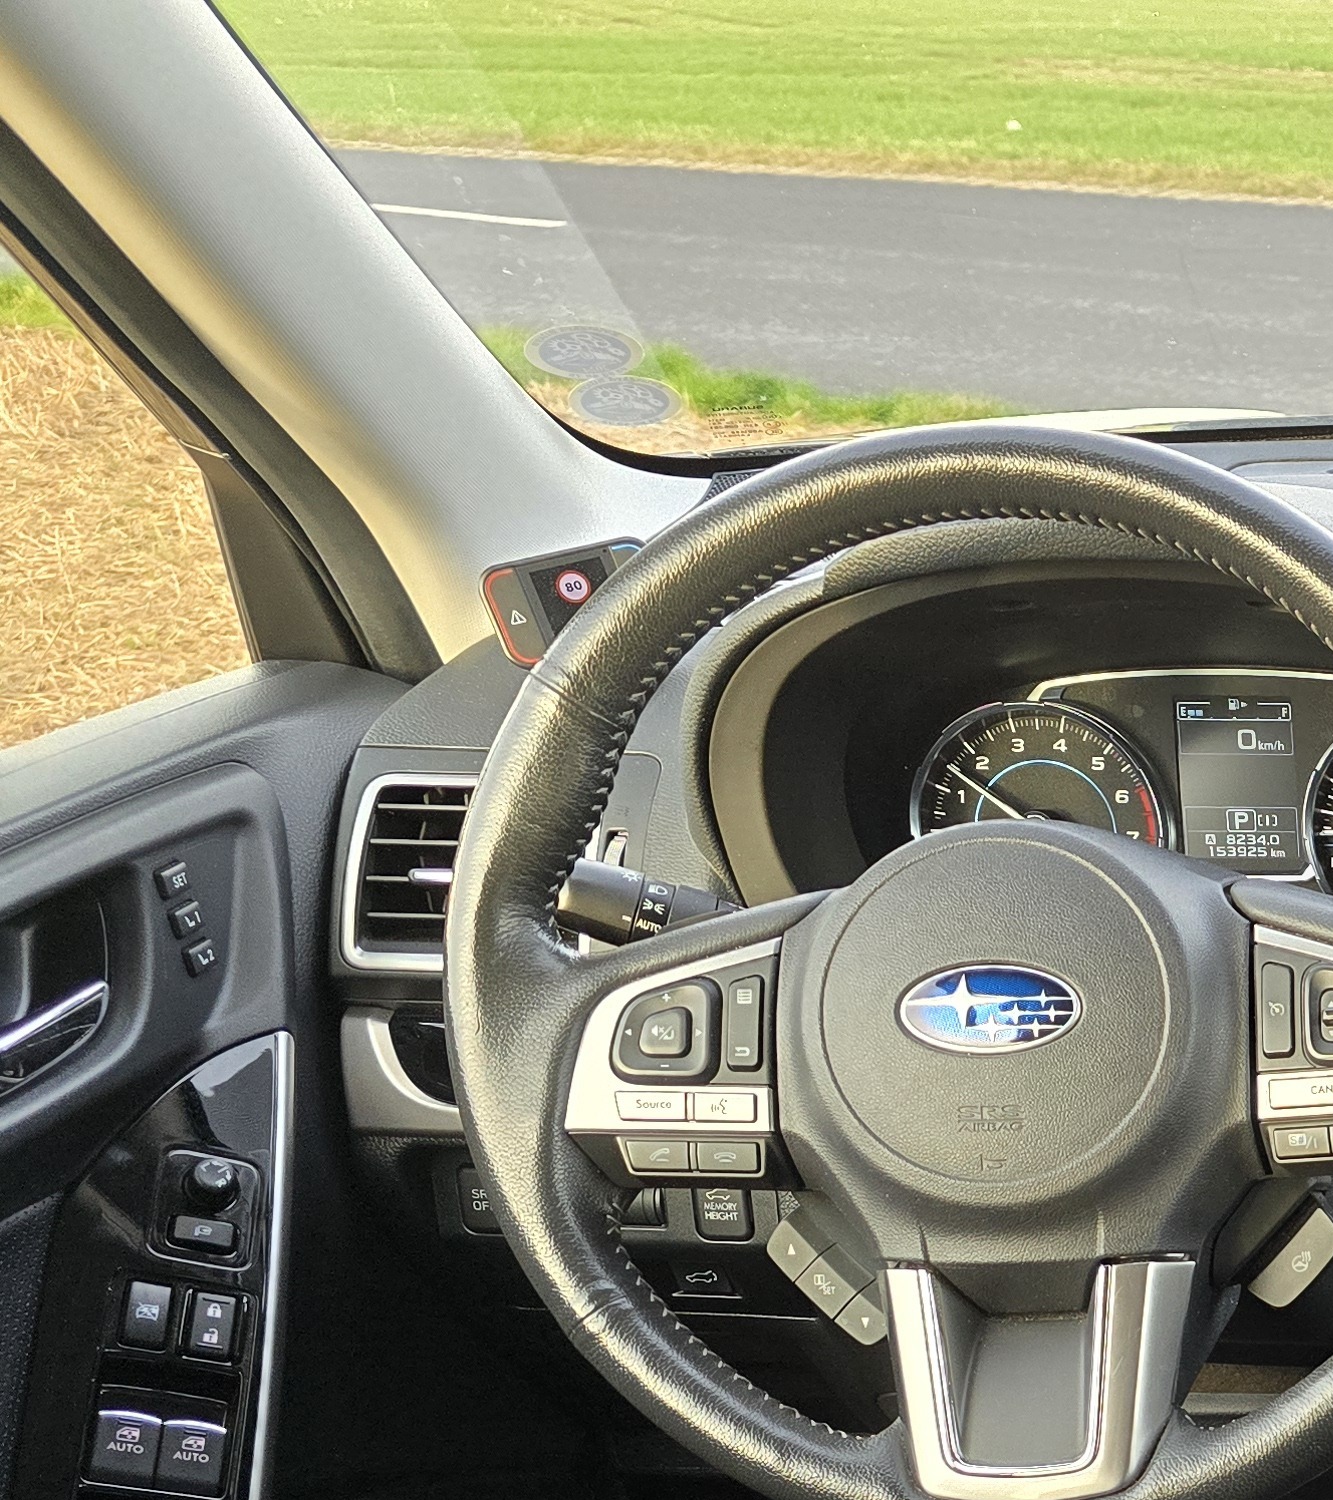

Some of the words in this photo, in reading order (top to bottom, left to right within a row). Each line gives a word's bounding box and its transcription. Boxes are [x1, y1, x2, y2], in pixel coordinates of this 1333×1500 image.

[565, 580, 583, 593] 80
[1180, 707, 1187, 717] E
[1281, 707, 1288, 717] F
[1011, 738, 1025, 752] 3
[1052, 738, 1067, 752] 4
[1237, 729, 1256, 750] 0
[1258, 740, 1285, 751] km/h
[976, 756, 990, 770] 2
[1091, 757, 1105, 771] 5
[957, 790, 965, 804] 1
[1115, 790, 1129, 804] 6
[1234, 811, 1249, 829] P
[1226, 834, 1280, 845] 8234.0
[1209, 846, 1268, 857] 153925
[1270, 847, 1286, 858] km
[172, 871, 188, 889] SET
[184, 910, 201, 928] L1
[636, 918, 662, 934] AUTO
[198, 948, 215, 966] L2
[471, 1188, 488, 1199] SR
[472, 1200, 490, 1211] OF
[704, 1202, 738, 1211] MEMORY
[704, 1211, 739, 1221] HEIGHT
[106, 1441, 144, 1454] AUTO
[172, 1451, 210, 1463] AUTO
